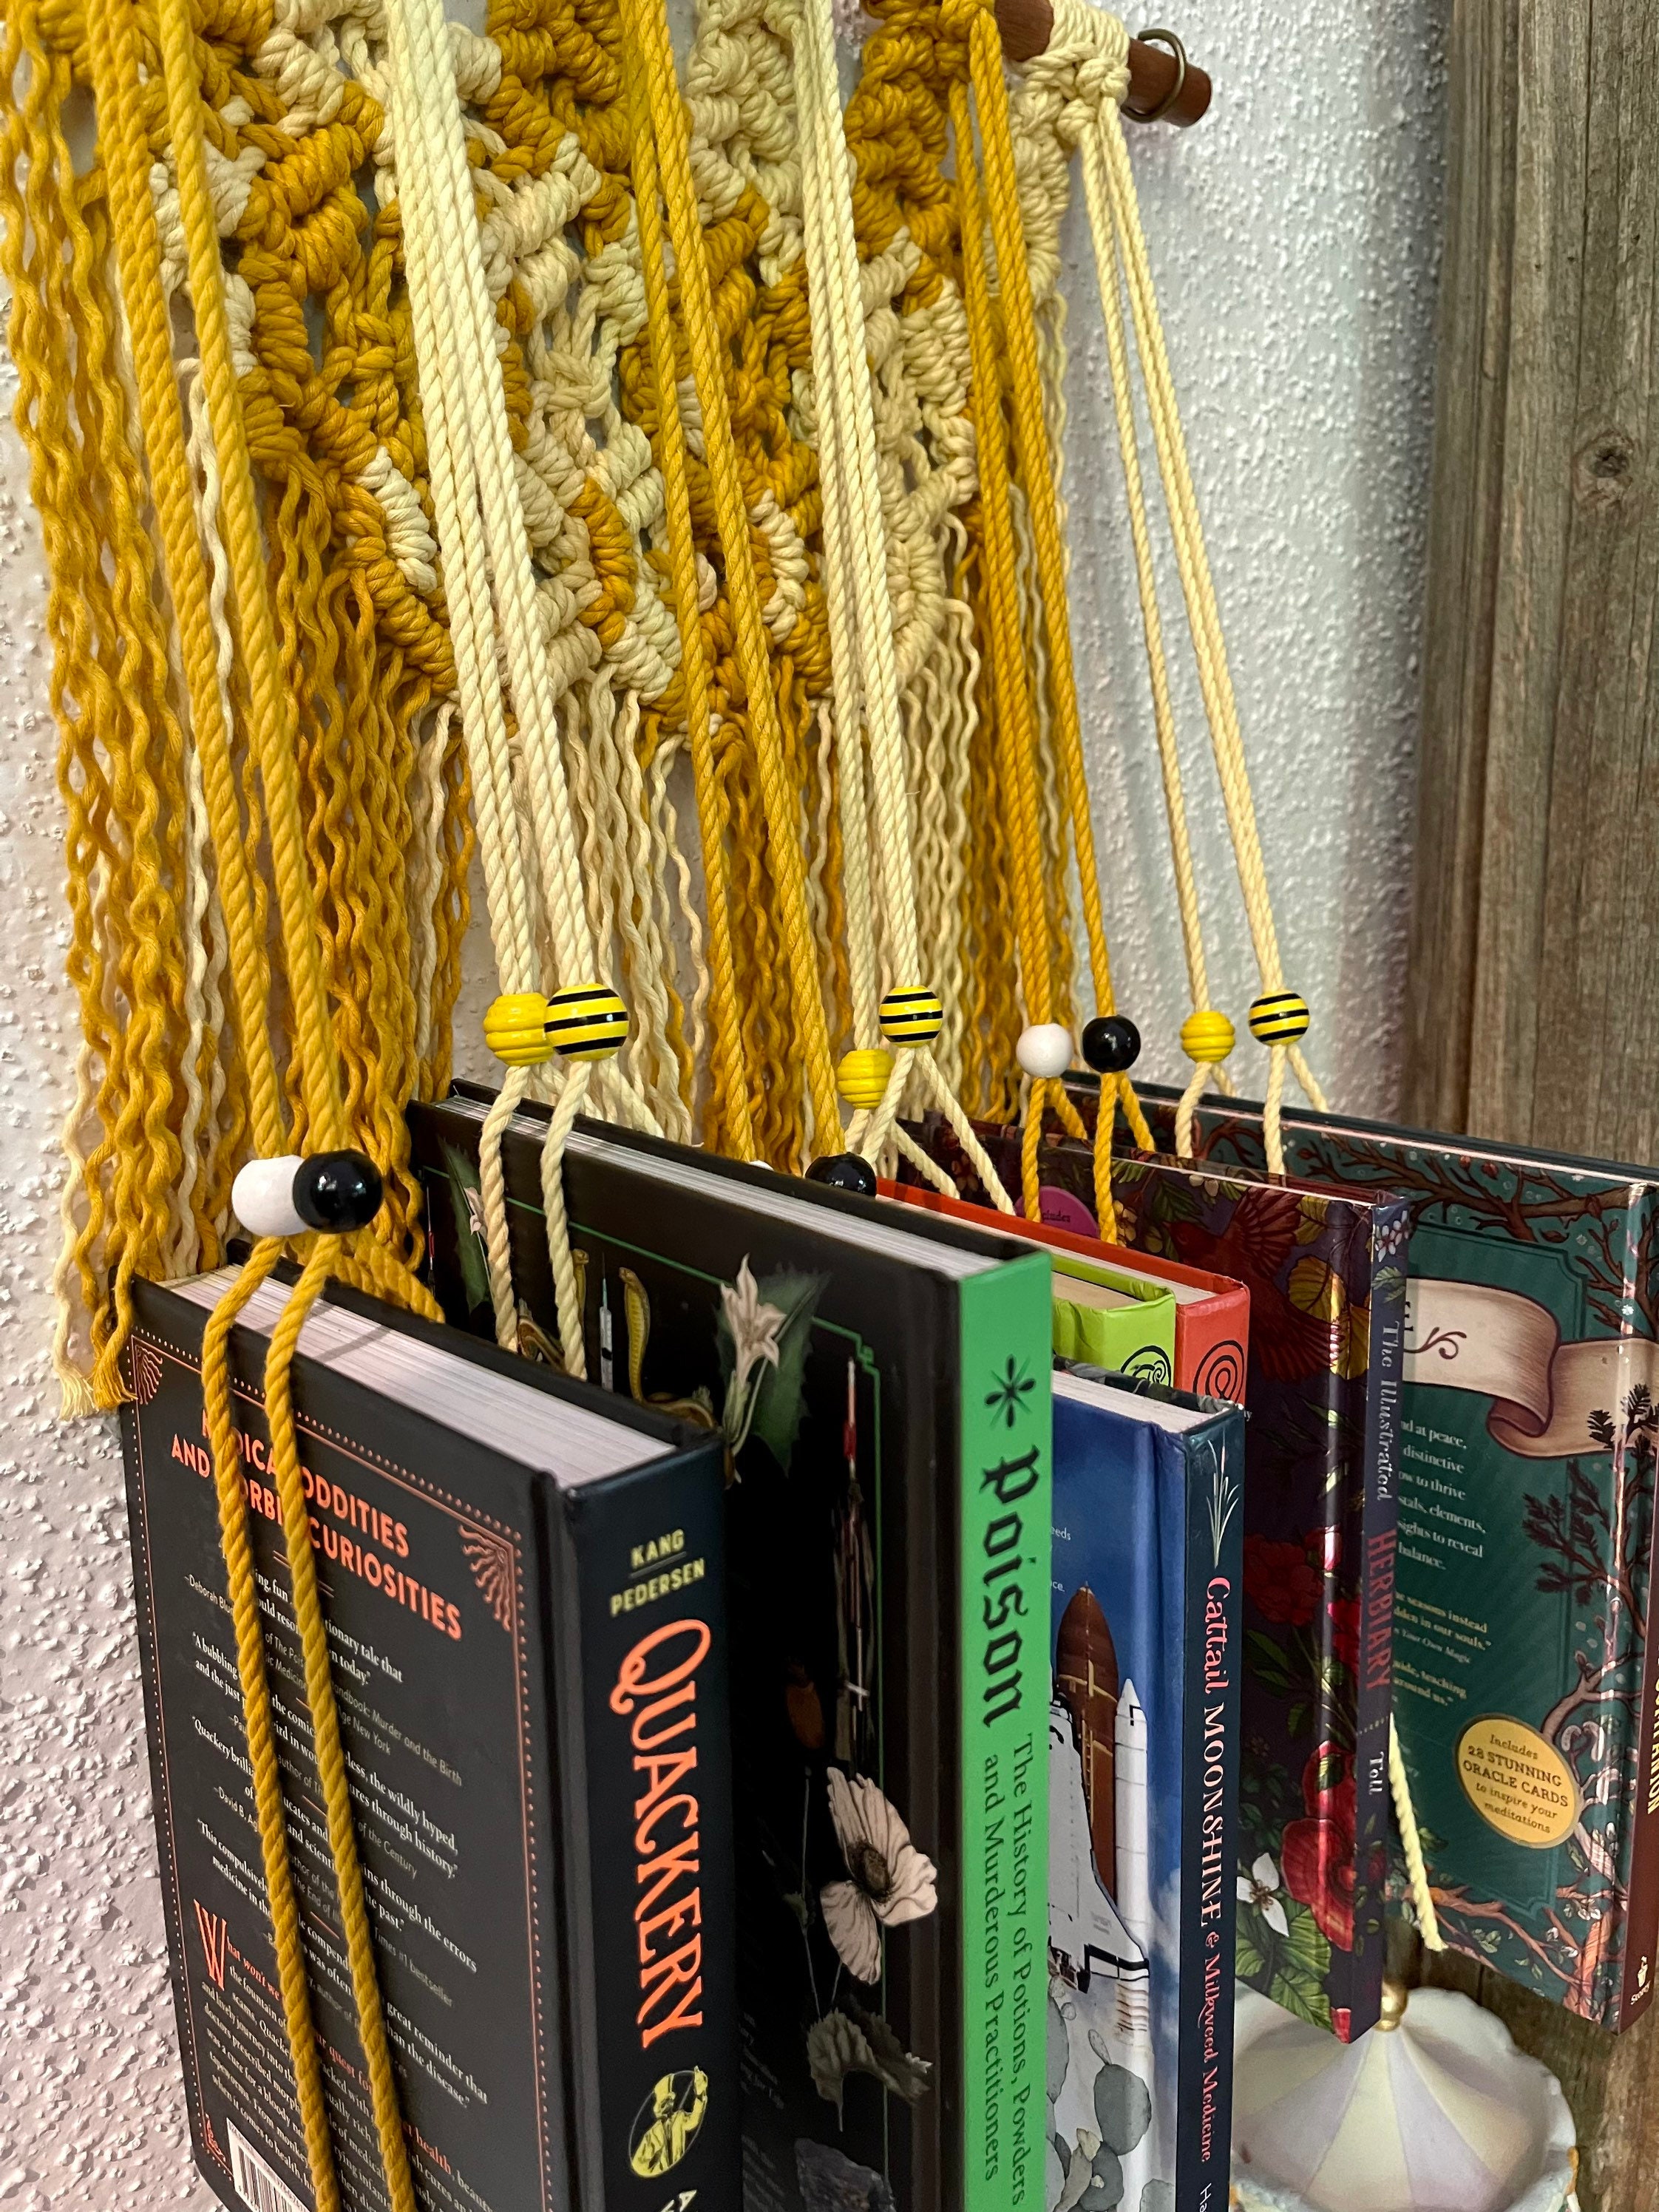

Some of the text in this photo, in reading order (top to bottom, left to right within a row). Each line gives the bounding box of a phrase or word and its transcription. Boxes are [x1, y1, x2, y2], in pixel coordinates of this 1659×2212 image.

[1403, 1445, 1465, 1473] distinctive
[1429, 1430, 1467, 1449] peace.
[302, 1467, 409, 1558] ODDITIES
[1366, 1320, 1400, 1691] The Illustrated HERBIARY
[1416, 1476, 1428, 1487] to
[1431, 1479, 1466, 1500] thrive
[172, 1434, 210, 1477] AND
[308, 1517, 462, 1642] CURIOSITIES
[631, 1528, 685, 1570] KANG
[1433, 1530, 1483, 1558] to reveal
[273, 1579, 288, 1602] fun
[362, 1645, 379, 1666] tale
[381, 1657, 402, 1682] that
[611, 1557, 705, 1618] PEDERSEN
[979, 1444, 1039, 1728] poison
[1204, 1577, 1230, 1694] Cattail
[196, 1660, 210, 1677] and
[211, 1669, 223, 1688] the
[225, 1680, 240, 1701] just
[291, 1736, 299, 1749] in
[353, 1786, 369, 1806] ures
[372, 1799, 413, 1842] through
[203, 1638, 237, 1680] bubbling
[272, 1694, 285, 1714] the
[370, 1772, 385, 1794] the
[388, 1789, 420, 1824] wildly
[422, 1811, 458, 1855] hyped,
[265, 1633, 273, 1644] of
[275, 1636, 287, 1655] The
[373, 1709, 401, 1740] Murder
[404, 1737, 421, 1754] and
[423, 1748, 437, 1767] the
[440, 1760, 461, 1786] Birth
[353, 1717, 390, 1755] New York
[1490, 1734, 1538, 1760] Includes
[1201, 1702, 1225, 1927] MOONSHINE
[1368, 1751, 1384, 1794] Toll
[1463, 1760, 1568, 1807] ORACLE CARDS
[1476, 1782, 1558, 1819] to inspire your
[1487, 1751, 1562, 1787] STUNNING
[288, 1825, 303, 1843] and
[369, 1830, 381, 1847] the
[384, 1841, 416, 1879] Century
[610, 1618, 711, 2050] QUACKERY
[1485, 1802, 1550, 1833] meditations
[213, 1856, 247, 1895] medicine
[249, 1889, 257, 1905] in
[310, 1950, 325, 1970] was
[328, 1968, 351, 1995] often
[408, 2043, 424, 2066] the
[381, 1879, 422, 1924] through
[424, 1917, 441, 1940] the
[444, 1938, 476, 1972] errors
[984, 1754, 1005, 2182] and Murderous Practitioners
[1007, 1731, 1034, 2206] The History of Potions, Powders
[205, 2003, 231, 2038] doctors
[232, 2035, 271, 2083] prescribed
[268, 1983, 279, 2001] we
[330, 2046, 355, 2078] quest
[387, 2003, 411, 2030] great
[415, 2027, 463, 2079] reminder
[466, 2074, 487, 2103] that
[1198, 1953, 1220, 2063] Milkweed
[202, 1982, 215, 2001] and
[237, 2019, 265, 2057] journey
[267, 2052, 283, 2073] into
[339, 2128, 347, 2141] of
[350, 2139, 385, 2182] medical
[230, 1966, 242, 1985] the
[243, 1978, 277, 2022] fountain
[348, 2090, 369, 2117] with
[425, 2170, 452, 2202] cures
[263, 2087, 290, 2127] bloody
[1201, 2066, 1218, 2162] Medicine
[265, 2134, 273, 2148] to
